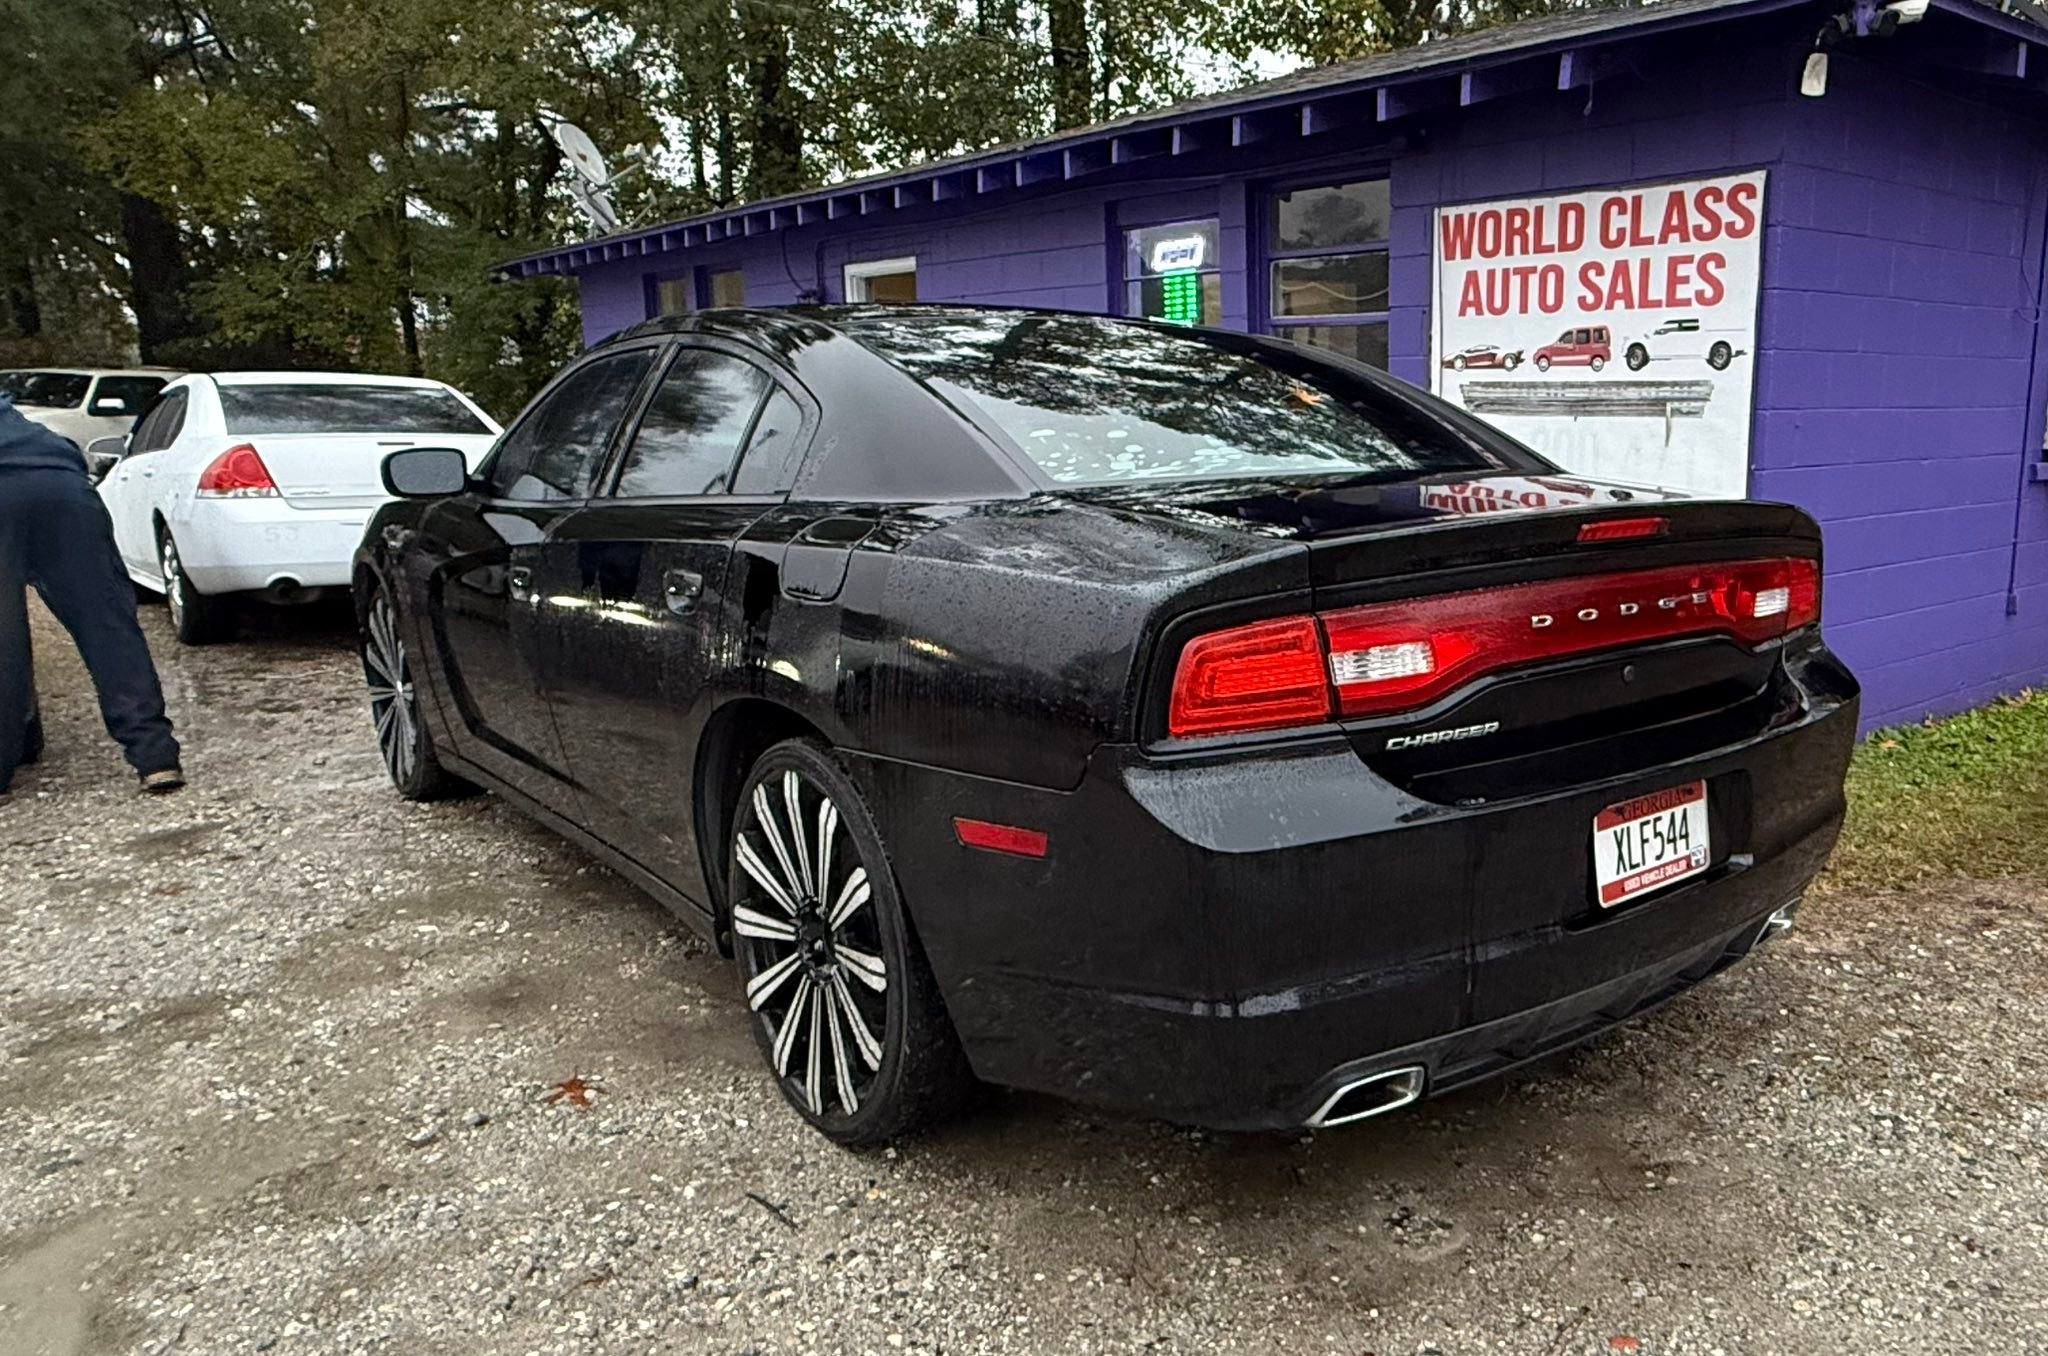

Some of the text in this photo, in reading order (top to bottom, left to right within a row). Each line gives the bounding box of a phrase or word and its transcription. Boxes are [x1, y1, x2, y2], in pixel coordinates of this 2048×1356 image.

[1441, 182, 1757, 262] WORLD CLASS
[1458, 252, 1726, 317] AUTO SALES
[1531, 592, 1707, 628] DODGE
[1385, 721, 1499, 751] CHARGER
[1621, 788, 1686, 821] GEORGIA
[1613, 807, 1690, 876] XLF544
